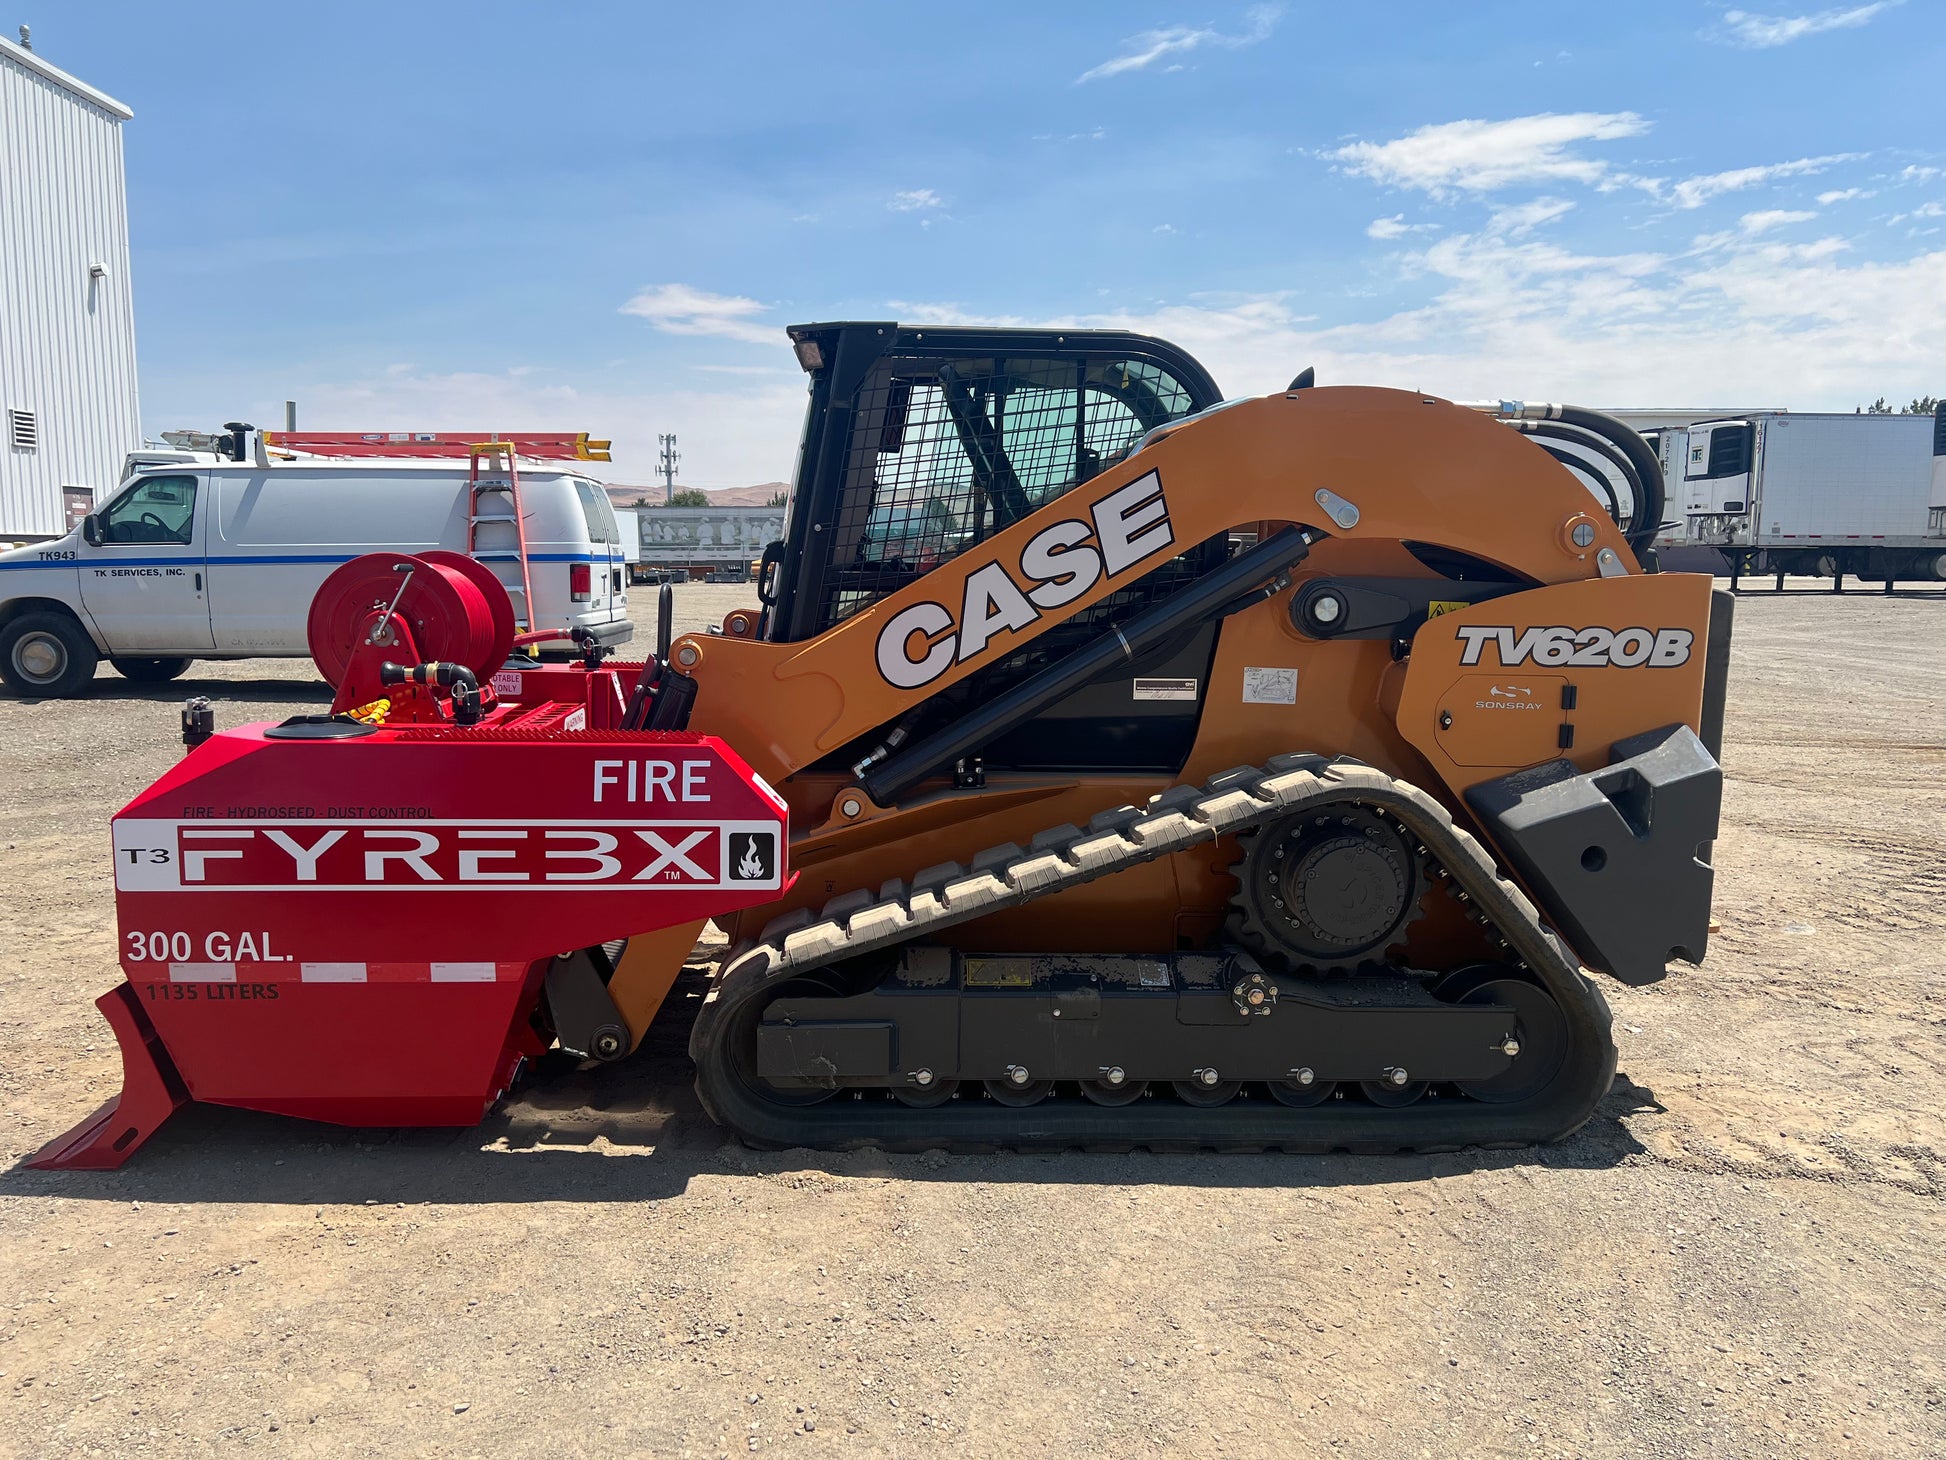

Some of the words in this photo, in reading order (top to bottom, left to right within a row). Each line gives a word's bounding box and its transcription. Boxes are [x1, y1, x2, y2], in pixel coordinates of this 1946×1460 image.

[39, 551, 76, 561] TK943
[111, 569, 162, 578] SERVICES,
[166, 569, 186, 577] INC.
[875, 466, 1175, 690] CASE
[1455, 625, 1694, 668] TV620B
[498, 684, 517, 693] ONLY
[1475, 701, 1543, 710] SONSRAY
[593, 760, 711, 803] FIRE
[183, 807, 215, 819] FIRE
[228, 807, 315, 819] HYDROSEED
[328, 807, 364, 819] DUST
[369, 807, 435, 819] CONTROL
[121, 848, 170, 864] T3
[127, 931, 192, 961] 300
[205, 931, 293, 962] GAL.
[146, 984, 199, 1000] 1135
[206, 983, 279, 1000] LITERS
